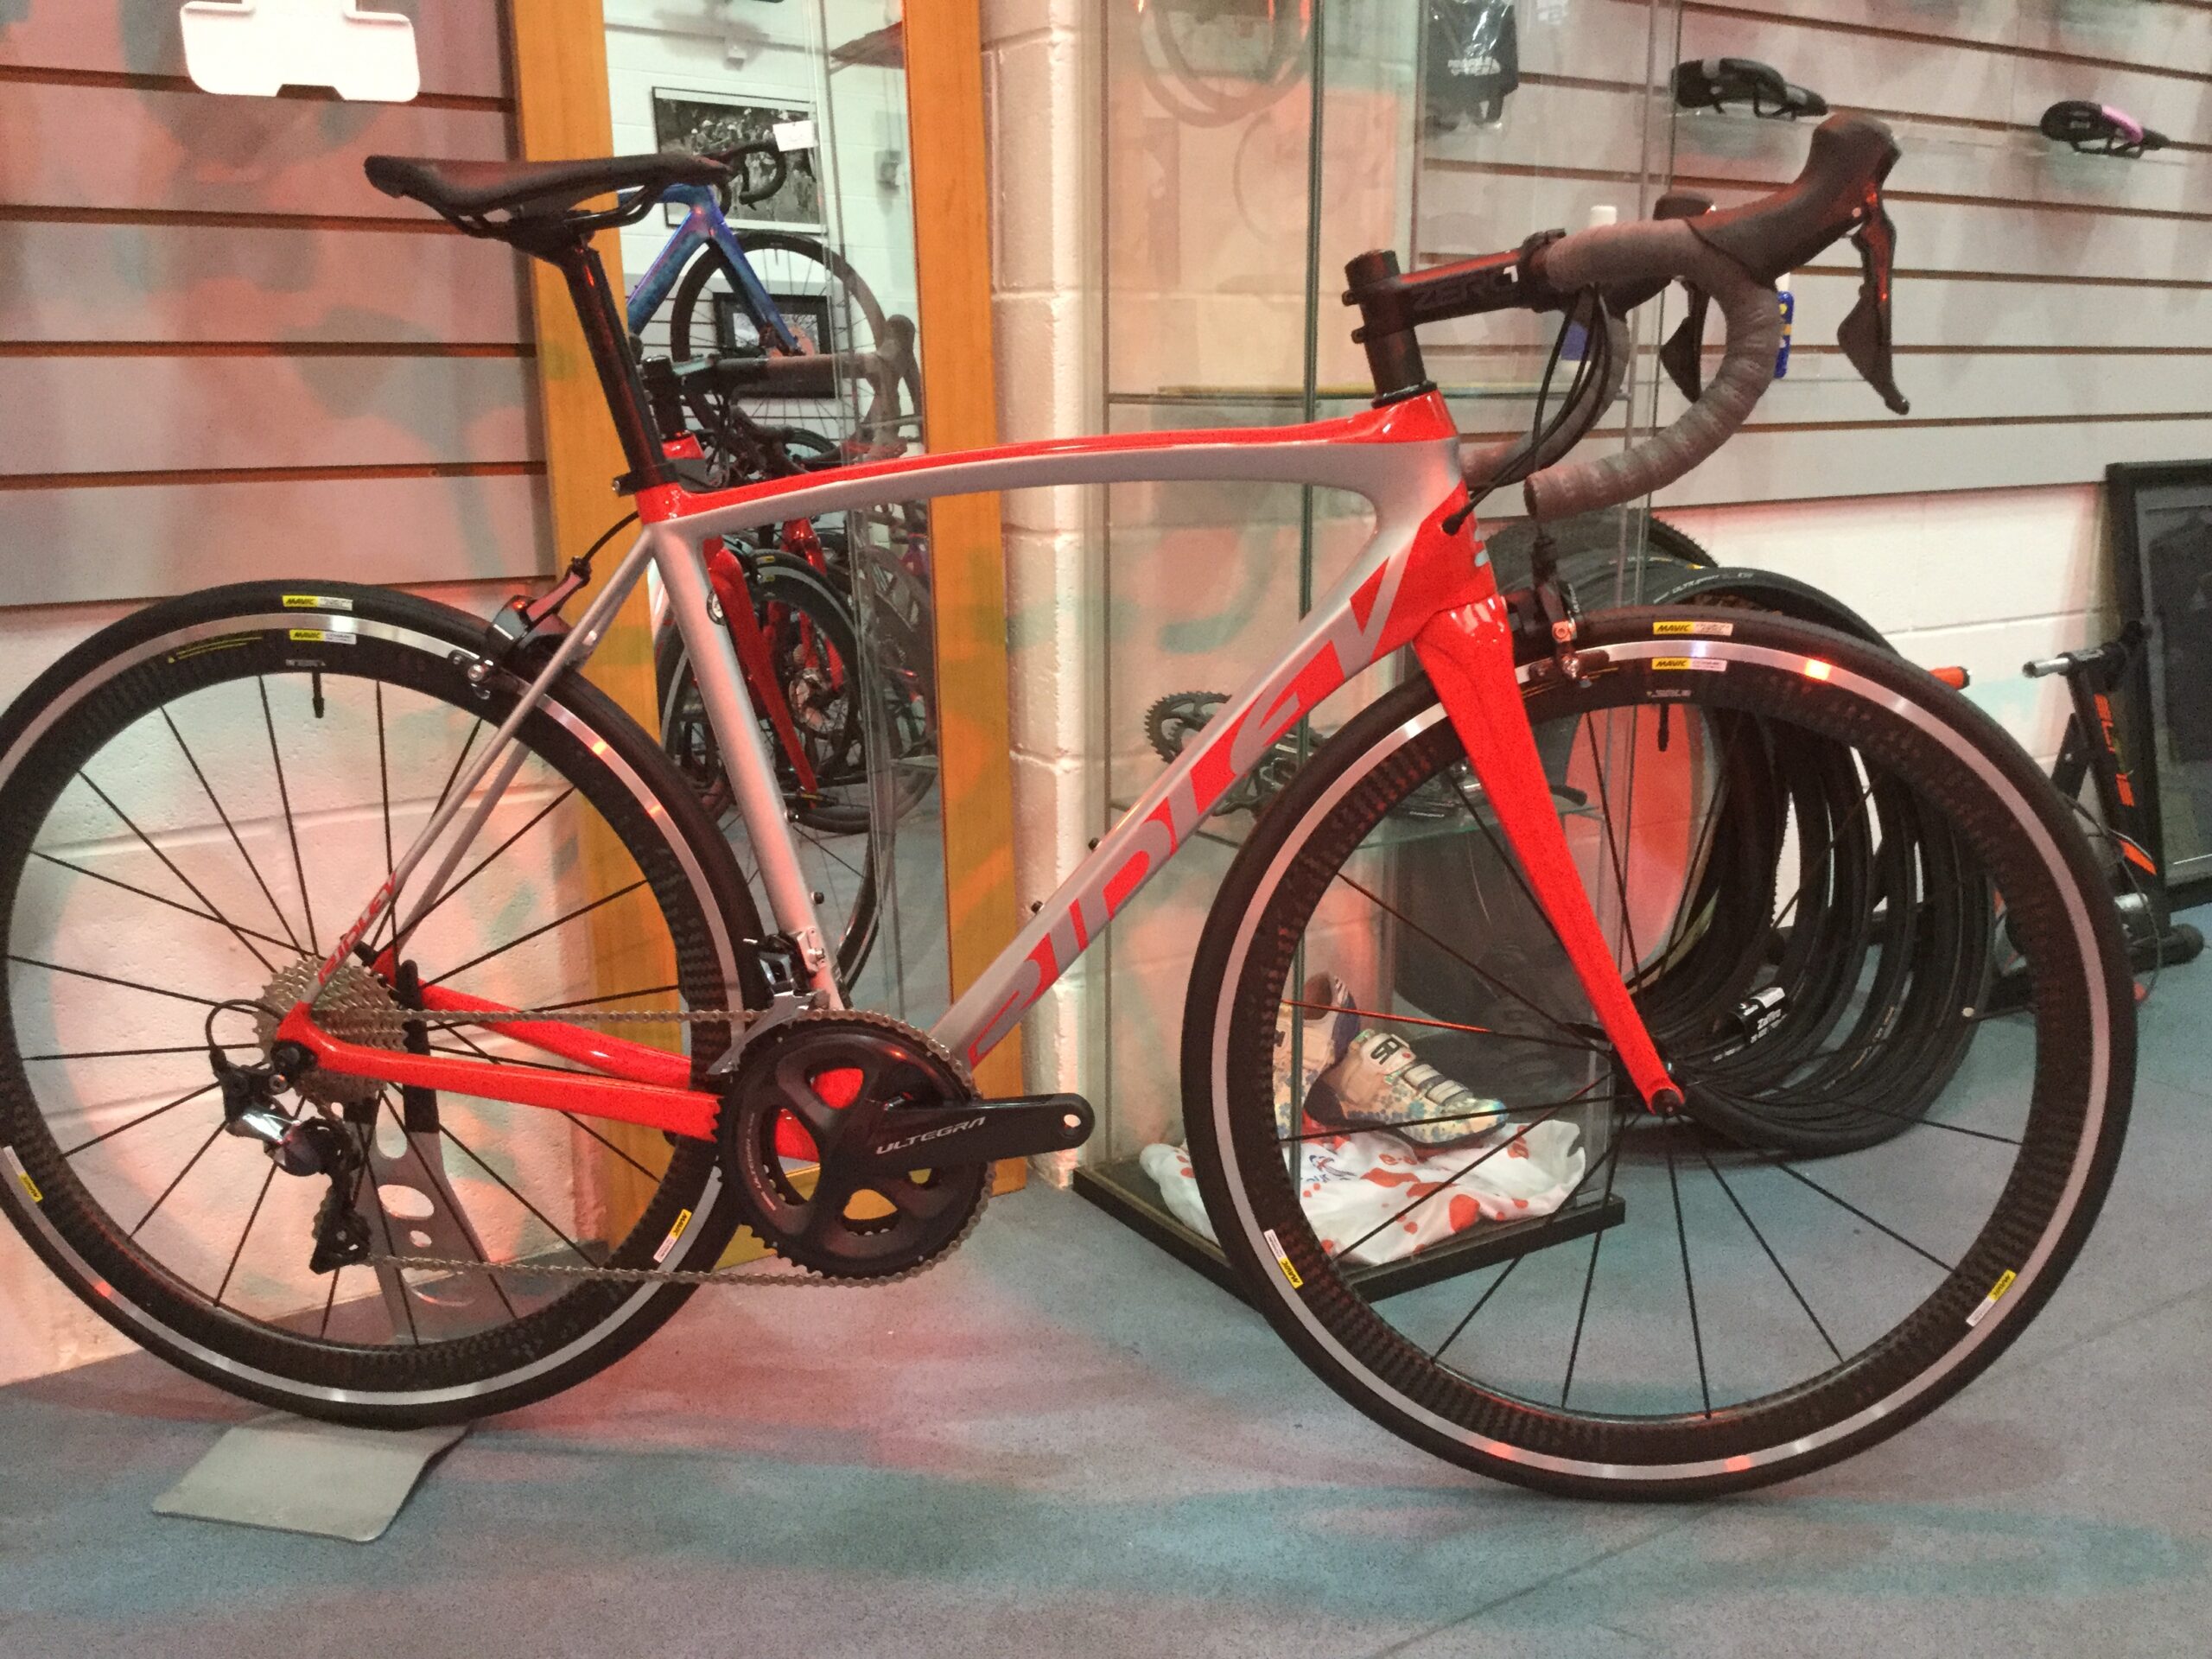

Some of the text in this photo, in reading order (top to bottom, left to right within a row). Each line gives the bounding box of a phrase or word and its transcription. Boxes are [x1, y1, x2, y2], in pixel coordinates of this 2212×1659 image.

[1656, 624, 1691, 632] MAVIC
[972, 549, 1419, 1061] RIDLEY
[317, 871, 397, 987] RIDLEY
[876, 1116, 986, 1154] ULTEGRA
[673, 1212, 688, 1236] MAVIC
[1281, 1260, 1300, 1284] MAVIC
